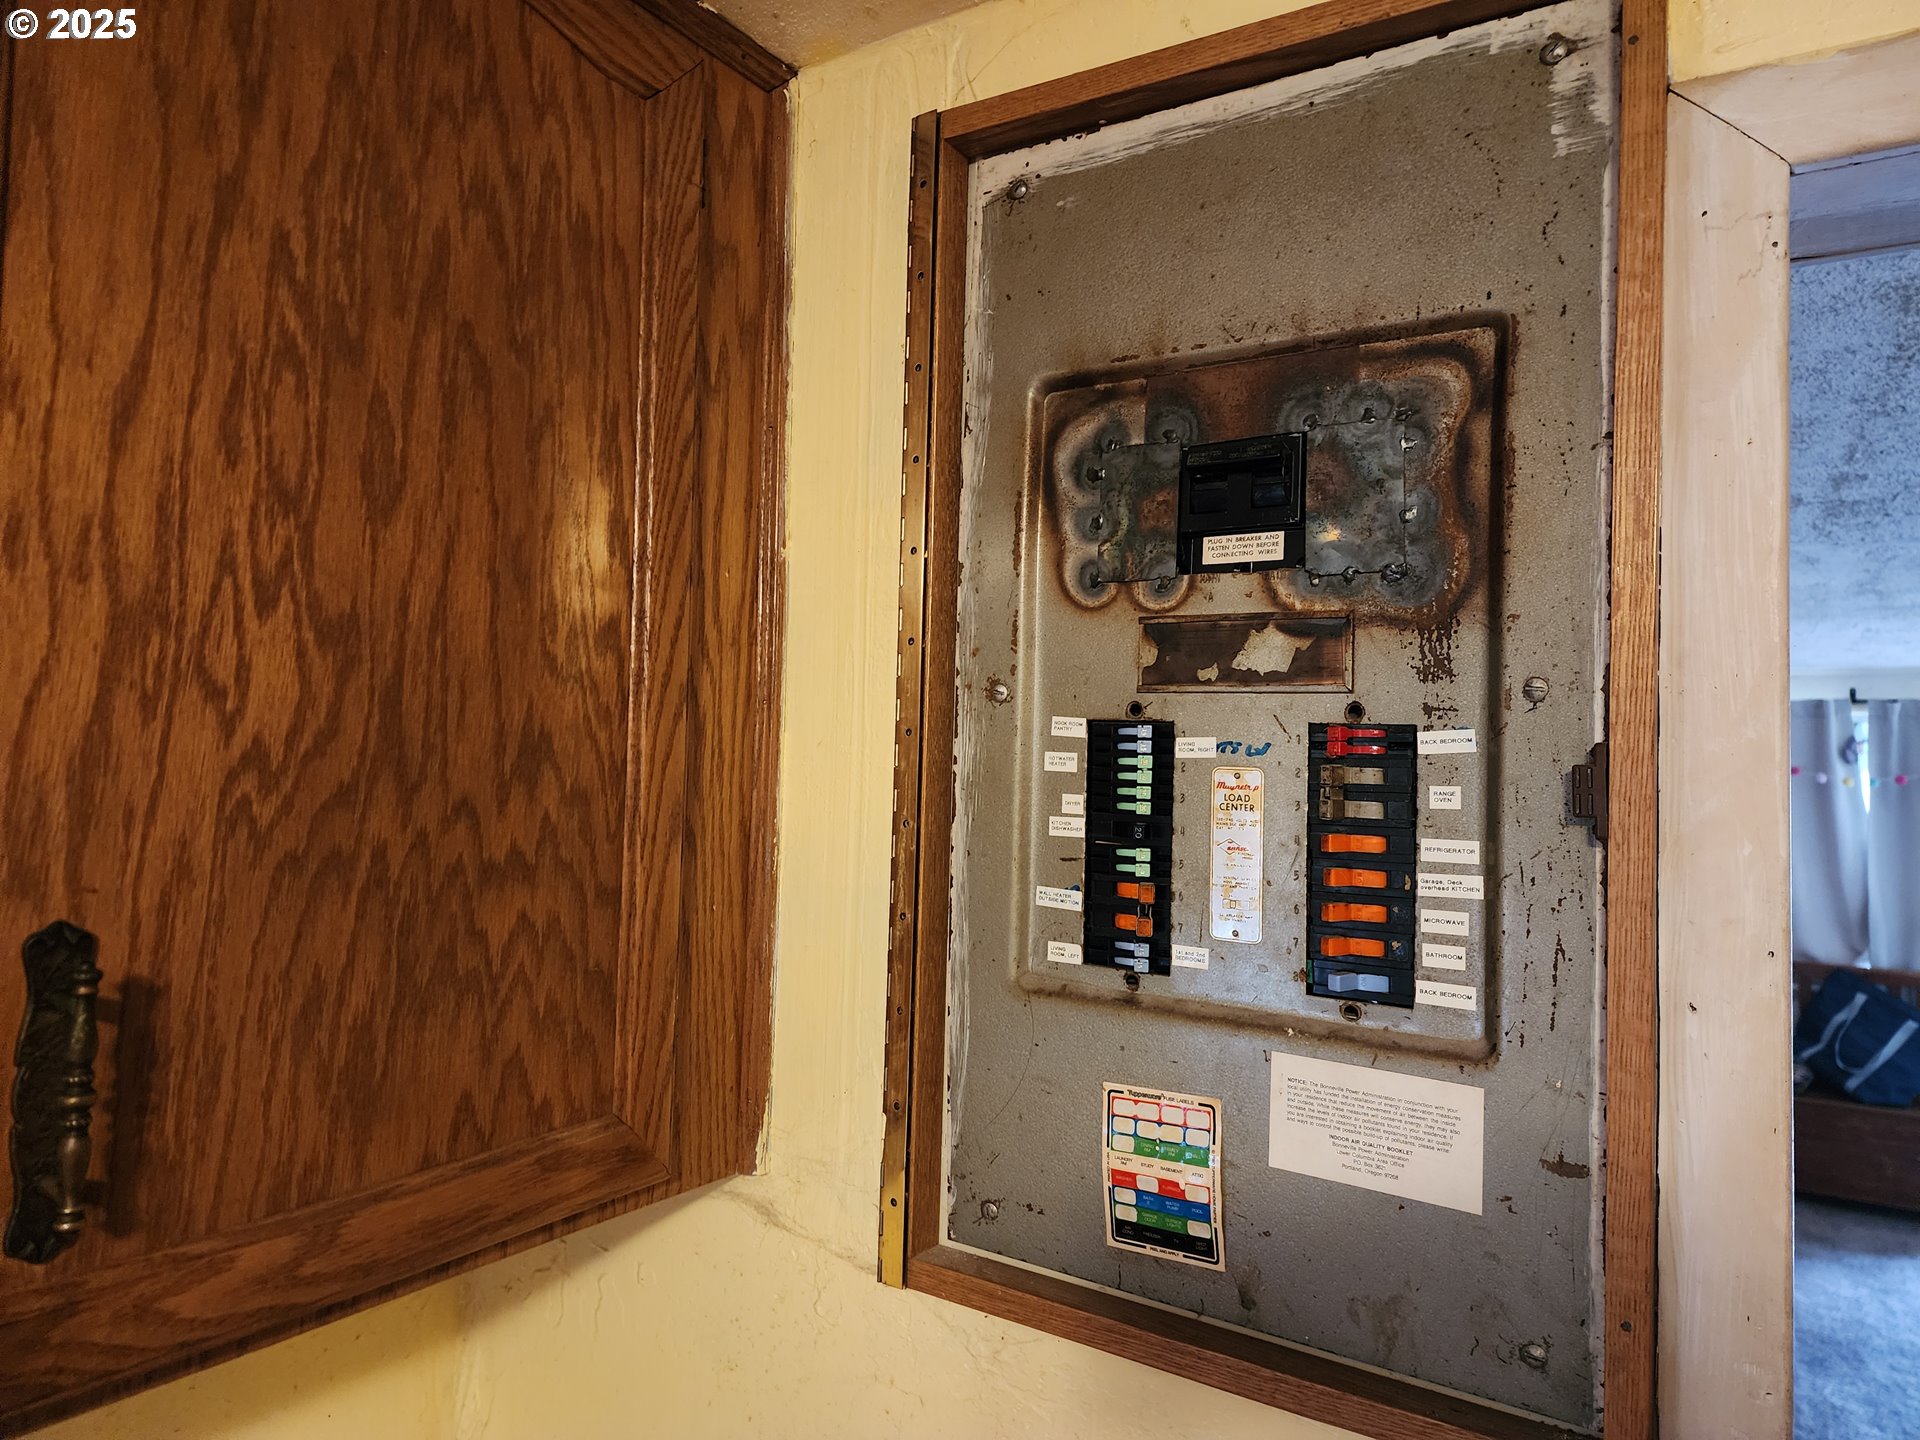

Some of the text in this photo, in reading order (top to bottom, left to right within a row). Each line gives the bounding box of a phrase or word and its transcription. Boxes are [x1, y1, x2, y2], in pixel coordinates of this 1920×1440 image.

[1212, 550, 1254, 558] CONNECTING
[1181, 763, 1185, 773] 2
[1295, 768, 1300, 778] 2
[1180, 794, 1185, 803] 3
[1224, 793, 1251, 802] LOAD
[1219, 803, 1255, 812] CENTER
[1295, 801, 1300, 811] 3
[1134, 827, 1142, 839] 20
[1180, 826, 1185, 836] 4
[1179, 860, 1184, 869] 5
[1294, 870, 1299, 880] 5
[1294, 904, 1299, 914] 6
[1424, 918, 1466, 926] MICROWAVE
[1178, 923, 1183, 933] 7
[1293, 938, 1299, 948] 7
[1175, 955, 1206, 963] BEDROOMS
[1425, 952, 1463, 960] BATHROOM
[1440, 991, 1473, 1000] BEDROOM
[1127, 1090, 1161, 1100] Tupperware
[1329, 1134, 1349, 1142] INDOOR
[1362, 1141, 1385, 1150] QUALITY
[1386, 1146, 1413, 1156] BOOKLET
